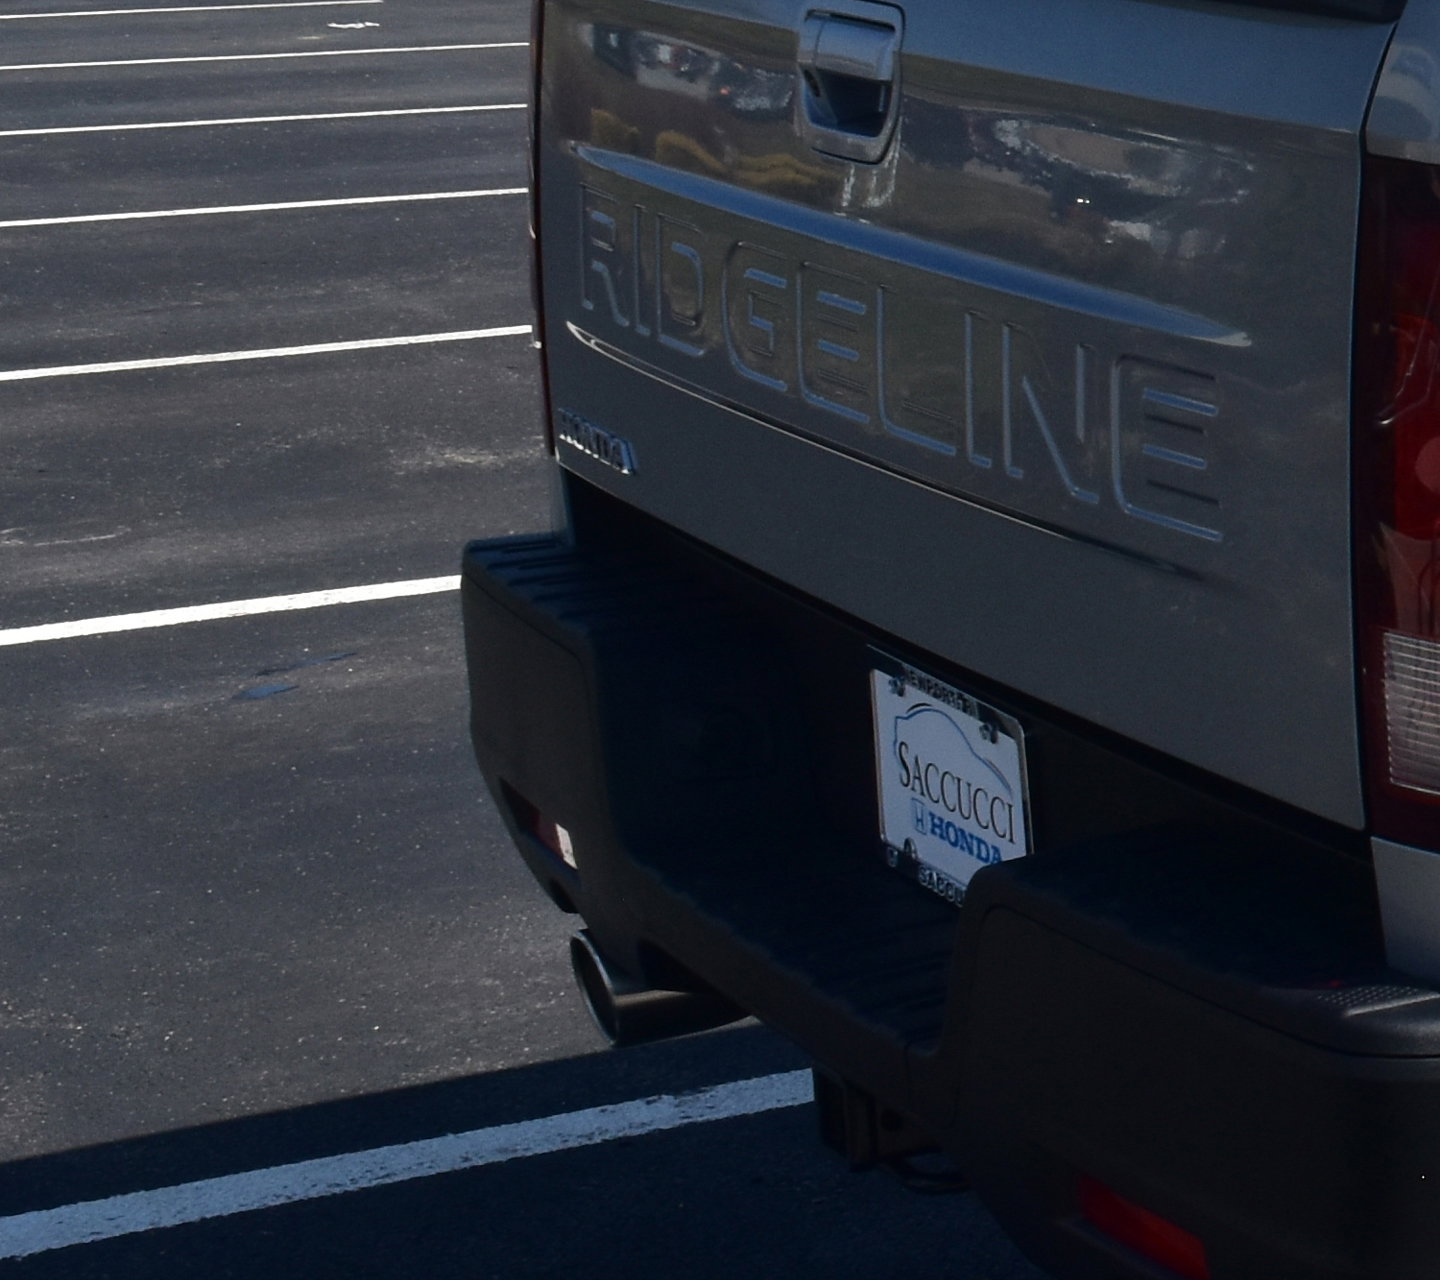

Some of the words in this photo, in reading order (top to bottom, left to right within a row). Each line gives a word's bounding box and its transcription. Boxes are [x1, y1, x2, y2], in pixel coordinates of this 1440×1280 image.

[577, 182, 1224, 543] RIDGELINE
[898, 740, 1017, 845] SACCUCCI
[928, 811, 1003, 866] HONDA
